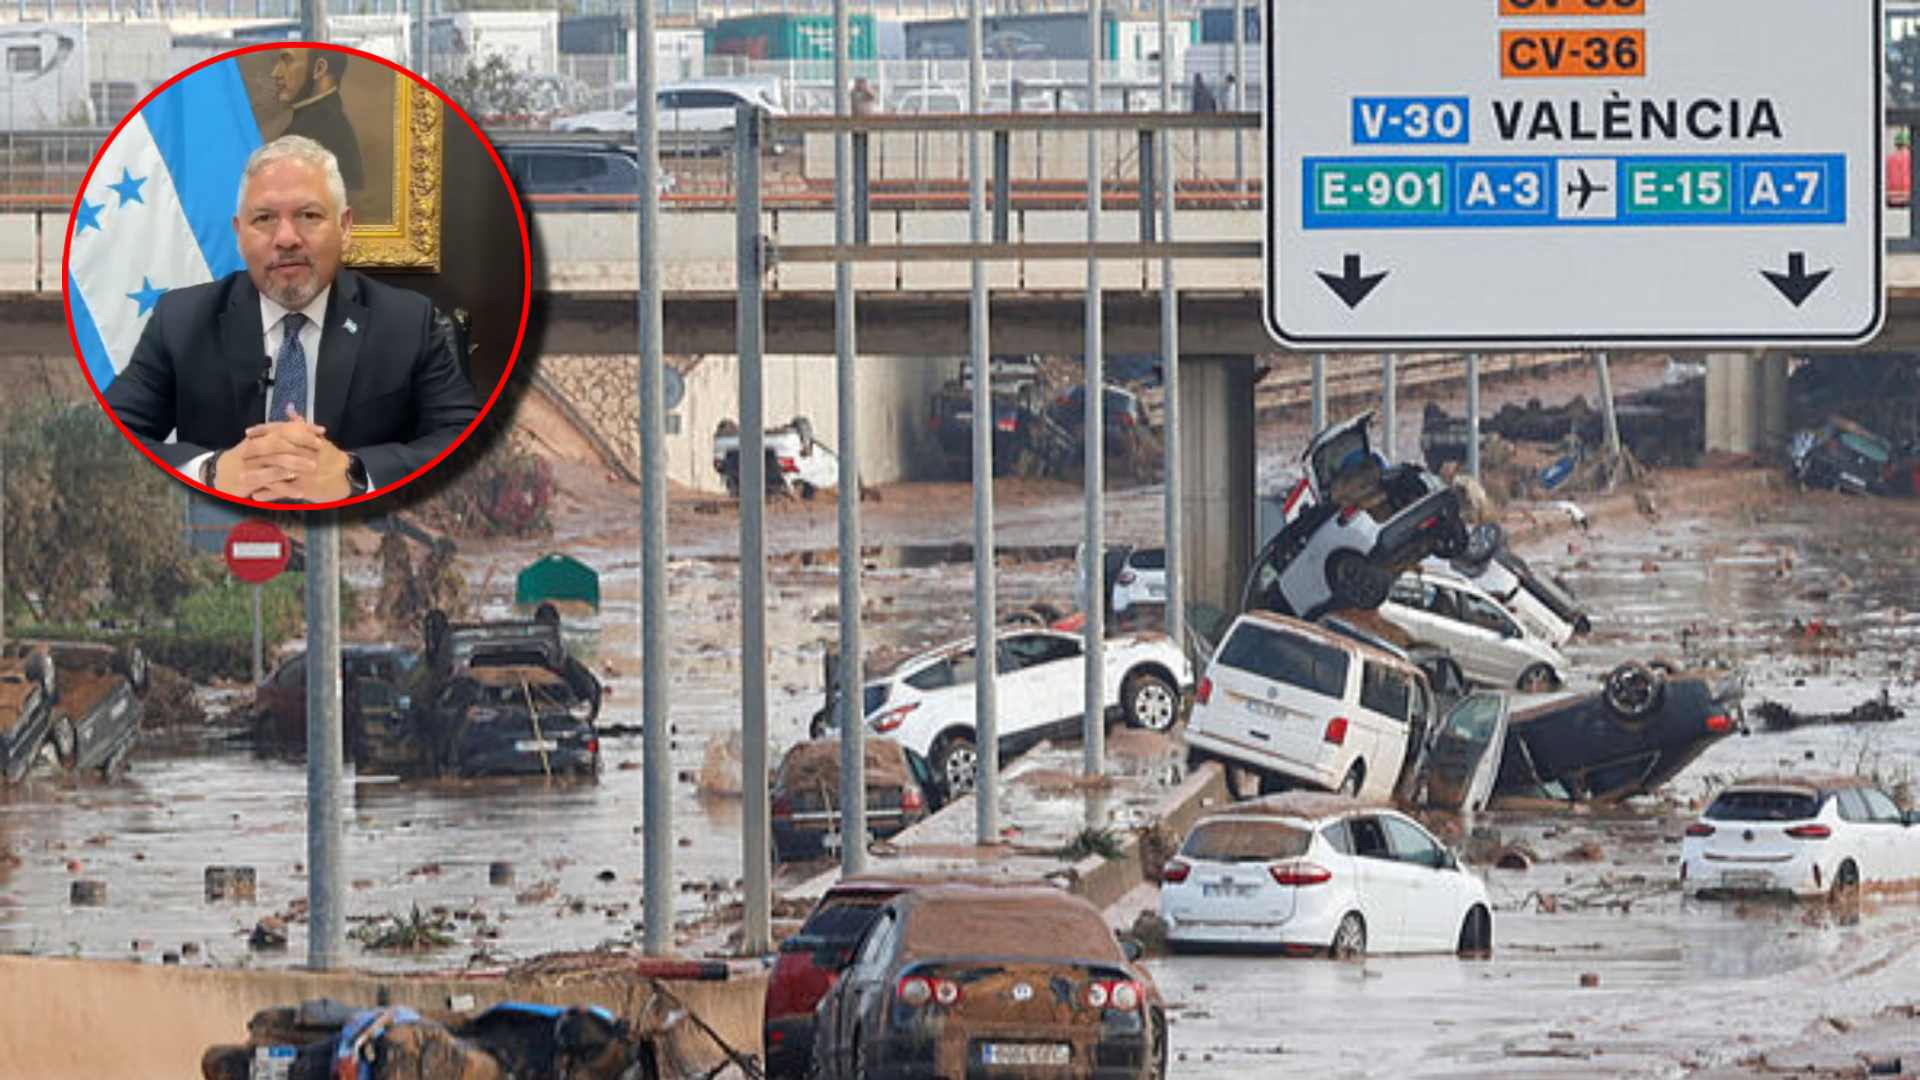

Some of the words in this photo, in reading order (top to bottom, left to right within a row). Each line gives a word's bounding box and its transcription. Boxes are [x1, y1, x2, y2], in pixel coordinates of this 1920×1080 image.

[1508, 36, 1638, 70] CV-36
[1360, 105, 1463, 138] V-30
[1493, 91, 1783, 140] VALÈNCIA
[1321, 172, 1443, 206] E-901
[1465, 172, 1541, 206] A-3
[1633, 172, 1723, 204] E-15
[1749, 171, 1820, 204] A-7
